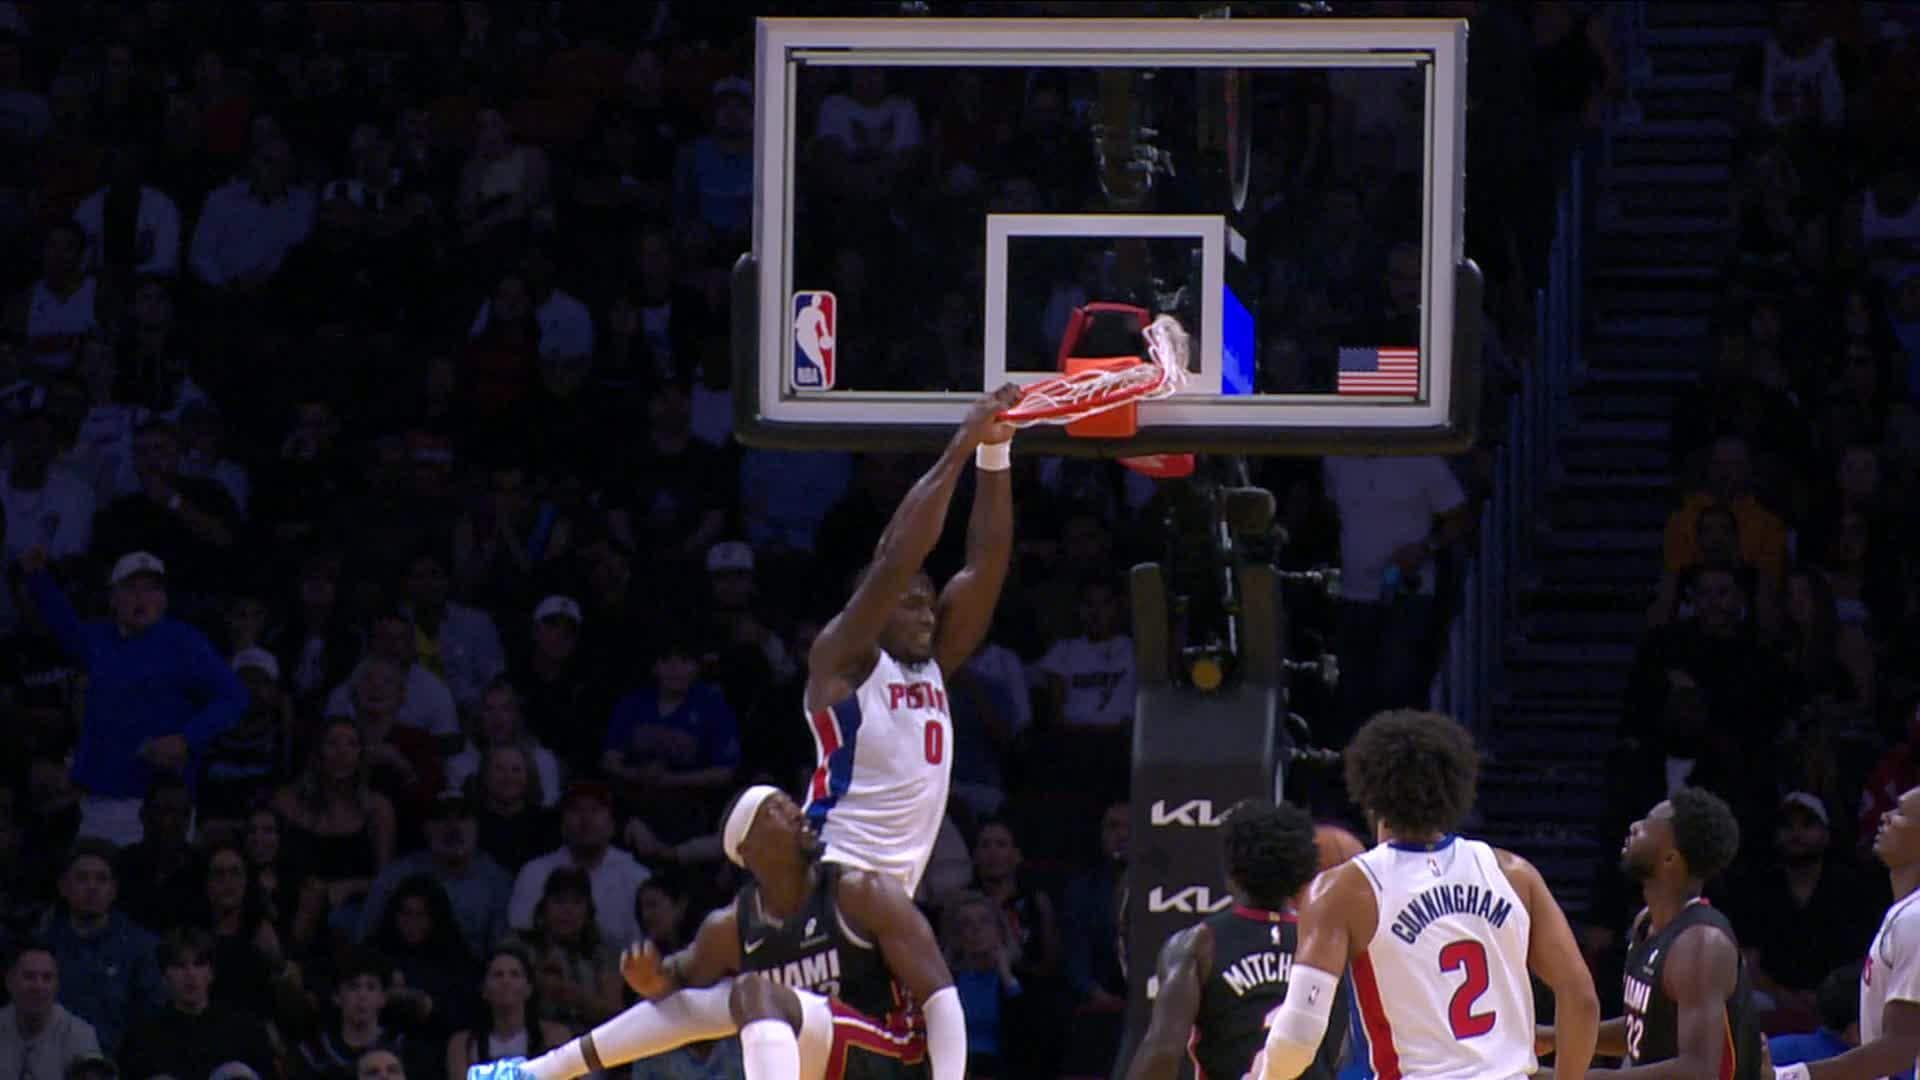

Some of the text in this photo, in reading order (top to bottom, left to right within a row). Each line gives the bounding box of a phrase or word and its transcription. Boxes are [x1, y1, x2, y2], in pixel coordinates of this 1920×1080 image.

[924, 719, 943, 766] 0
[1391, 884, 1512, 944] CUNNINGHAM
[751, 949, 841, 990] IAMI
[1221, 951, 1292, 996] MITCH
[1439, 940, 1497, 1041] 2
